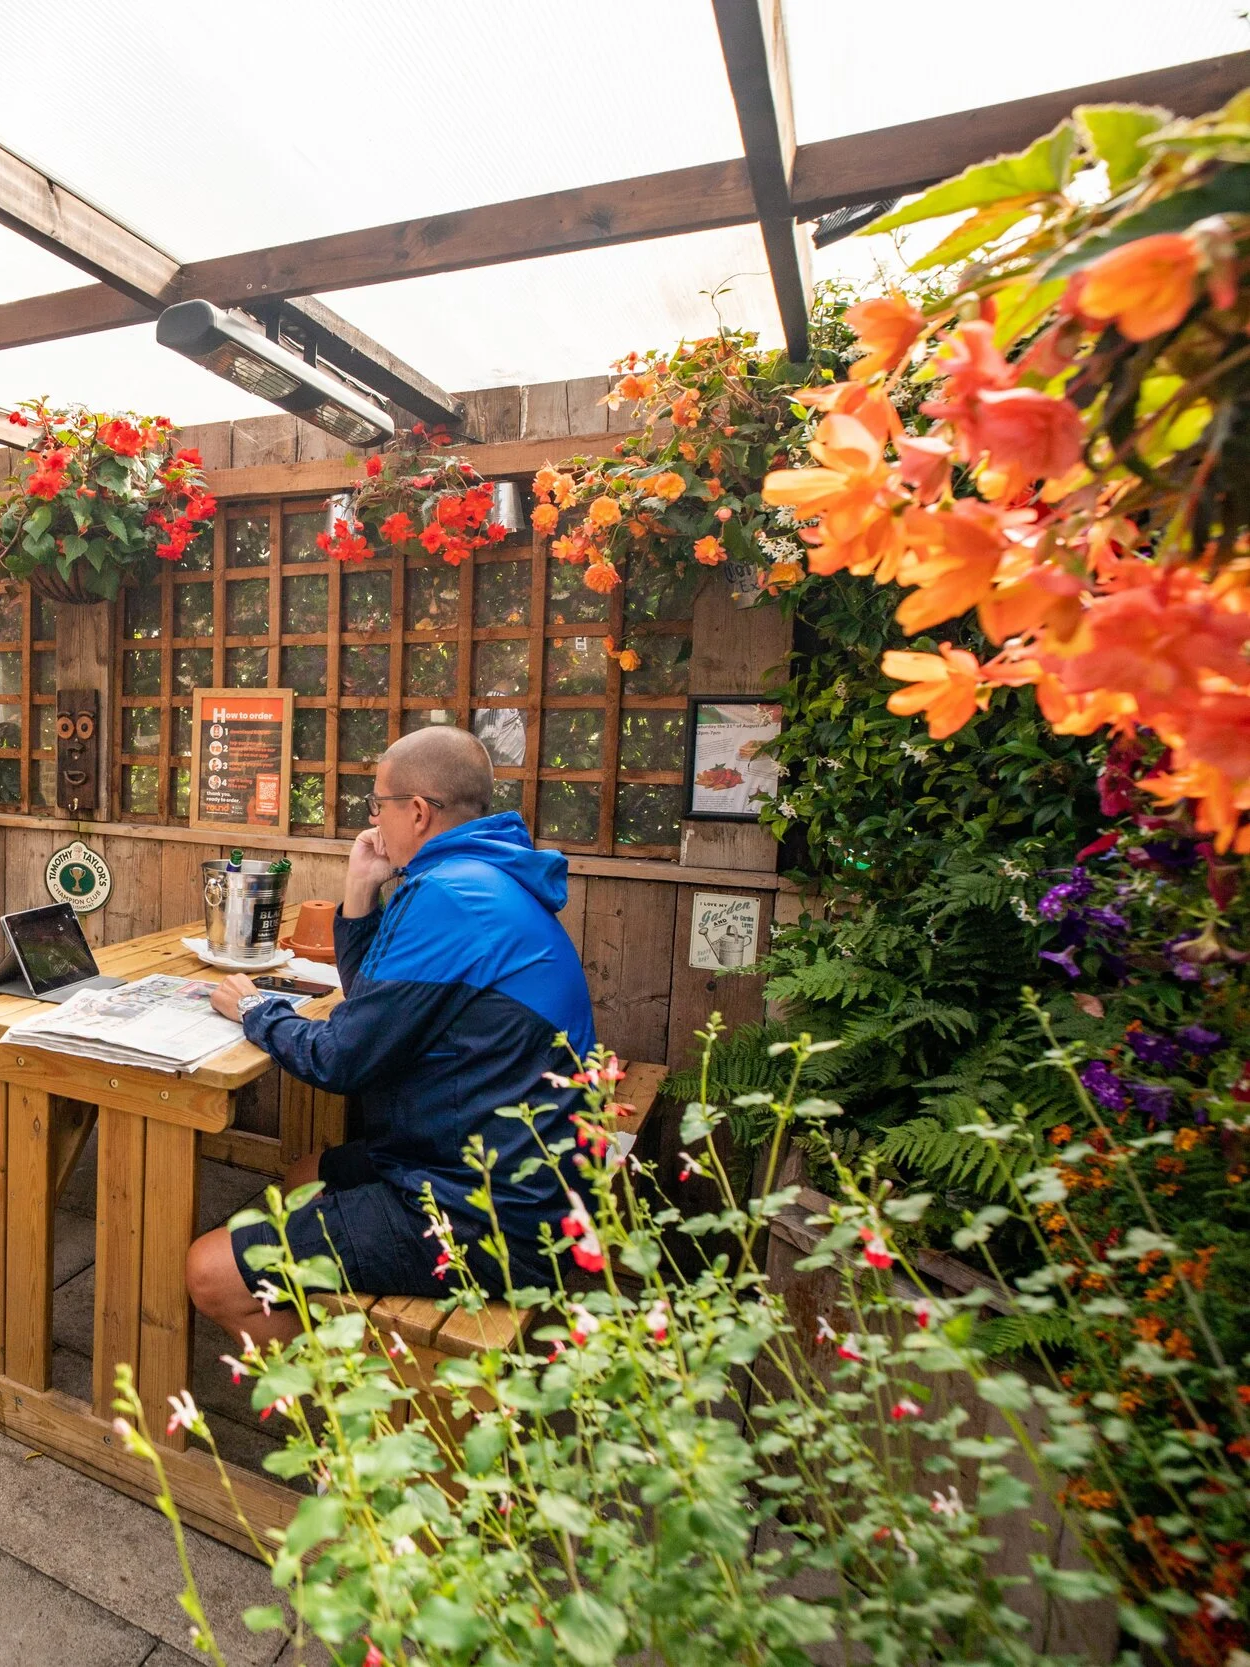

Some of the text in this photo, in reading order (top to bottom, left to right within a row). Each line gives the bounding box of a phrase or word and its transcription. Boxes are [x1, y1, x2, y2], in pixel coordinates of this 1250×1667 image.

[213, 708, 239, 723] How
[249, 712, 273, 720] order
[222, 762, 228, 770] 3
[222, 779, 227, 787] 4
[49, 850, 108, 887] TIMOTHY TAYLOR'S
[53, 883, 102, 905] CHAMPION CLUB
[698, 901, 750, 928] Garden
[714, 918, 728, 926] AND
